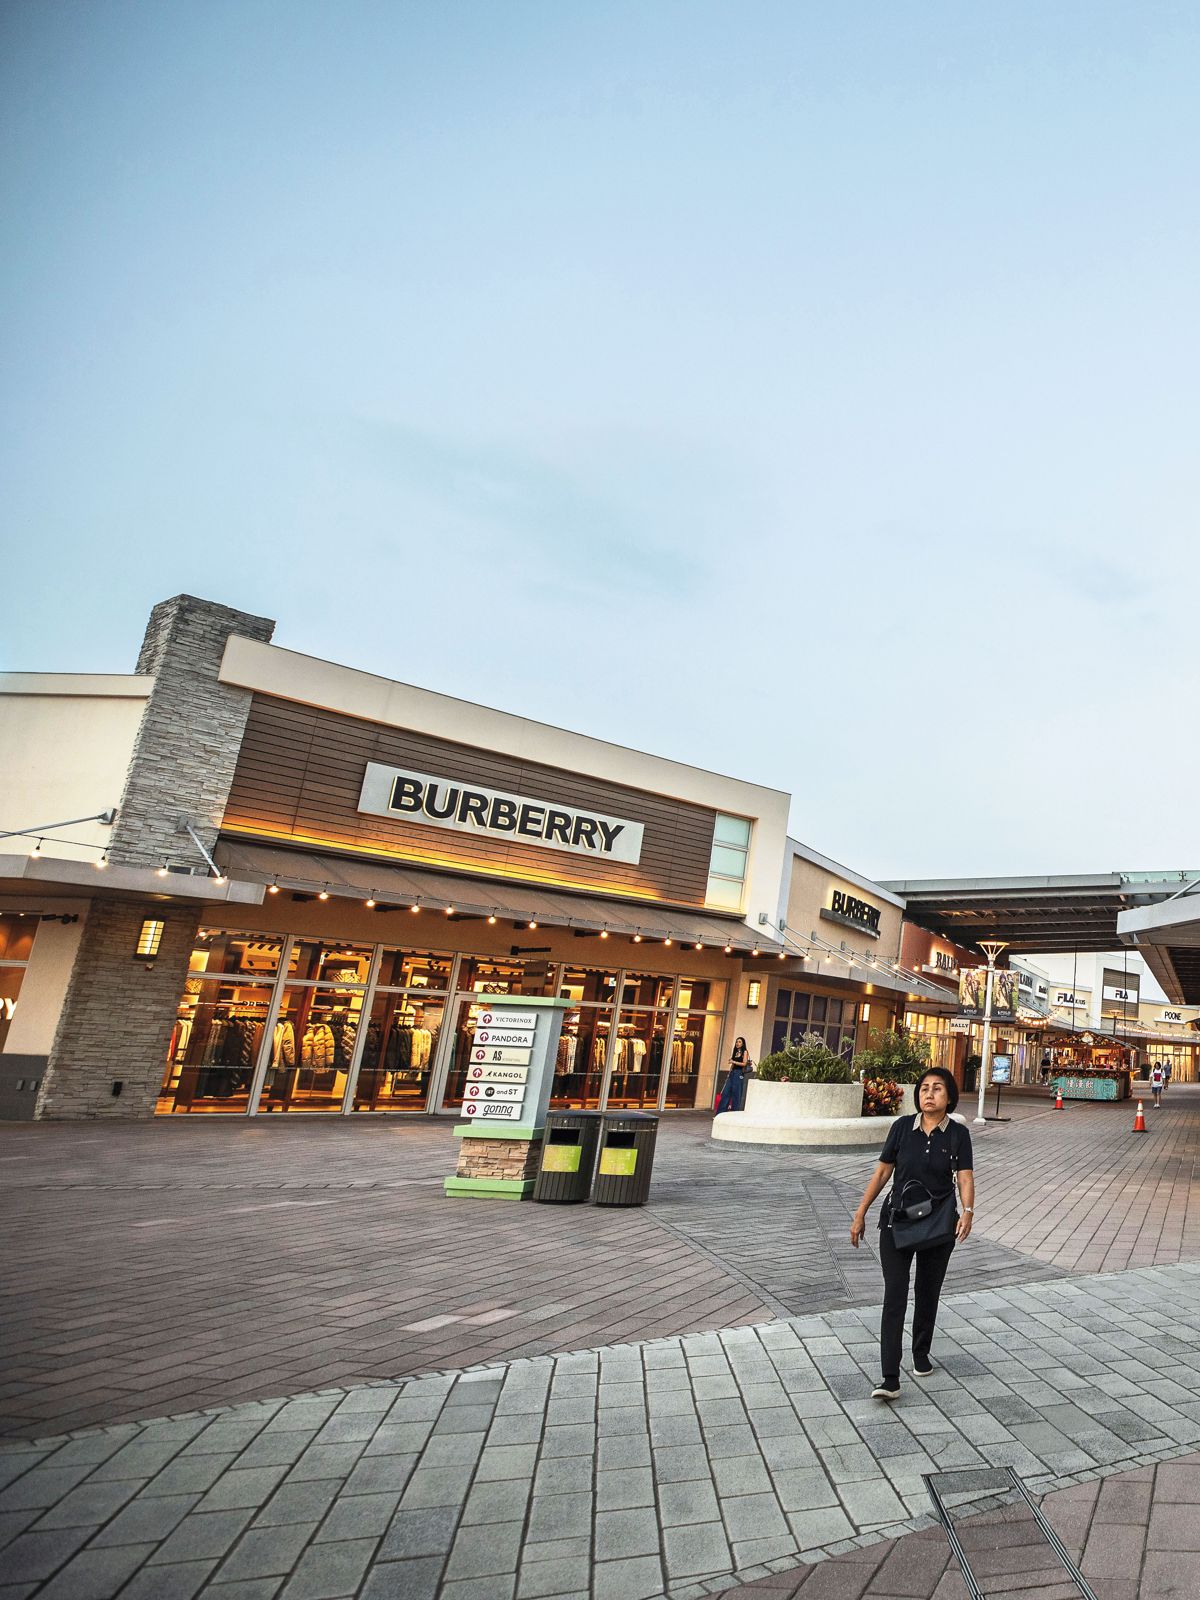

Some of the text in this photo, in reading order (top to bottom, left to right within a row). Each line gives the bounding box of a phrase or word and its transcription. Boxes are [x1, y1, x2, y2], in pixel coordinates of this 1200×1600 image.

[388, 775, 626, 853] BURBERRY
[1057, 992, 1075, 1004] FILA
[1115, 989, 1129, 1000] FILA
[495, 1016, 532, 1024] VICTORINOX
[491, 1034, 529, 1044] PANDORA
[492, 1050, 503, 1062] AS
[508, 1088, 519, 1096] ST
[482, 1104, 514, 1117] gonna
